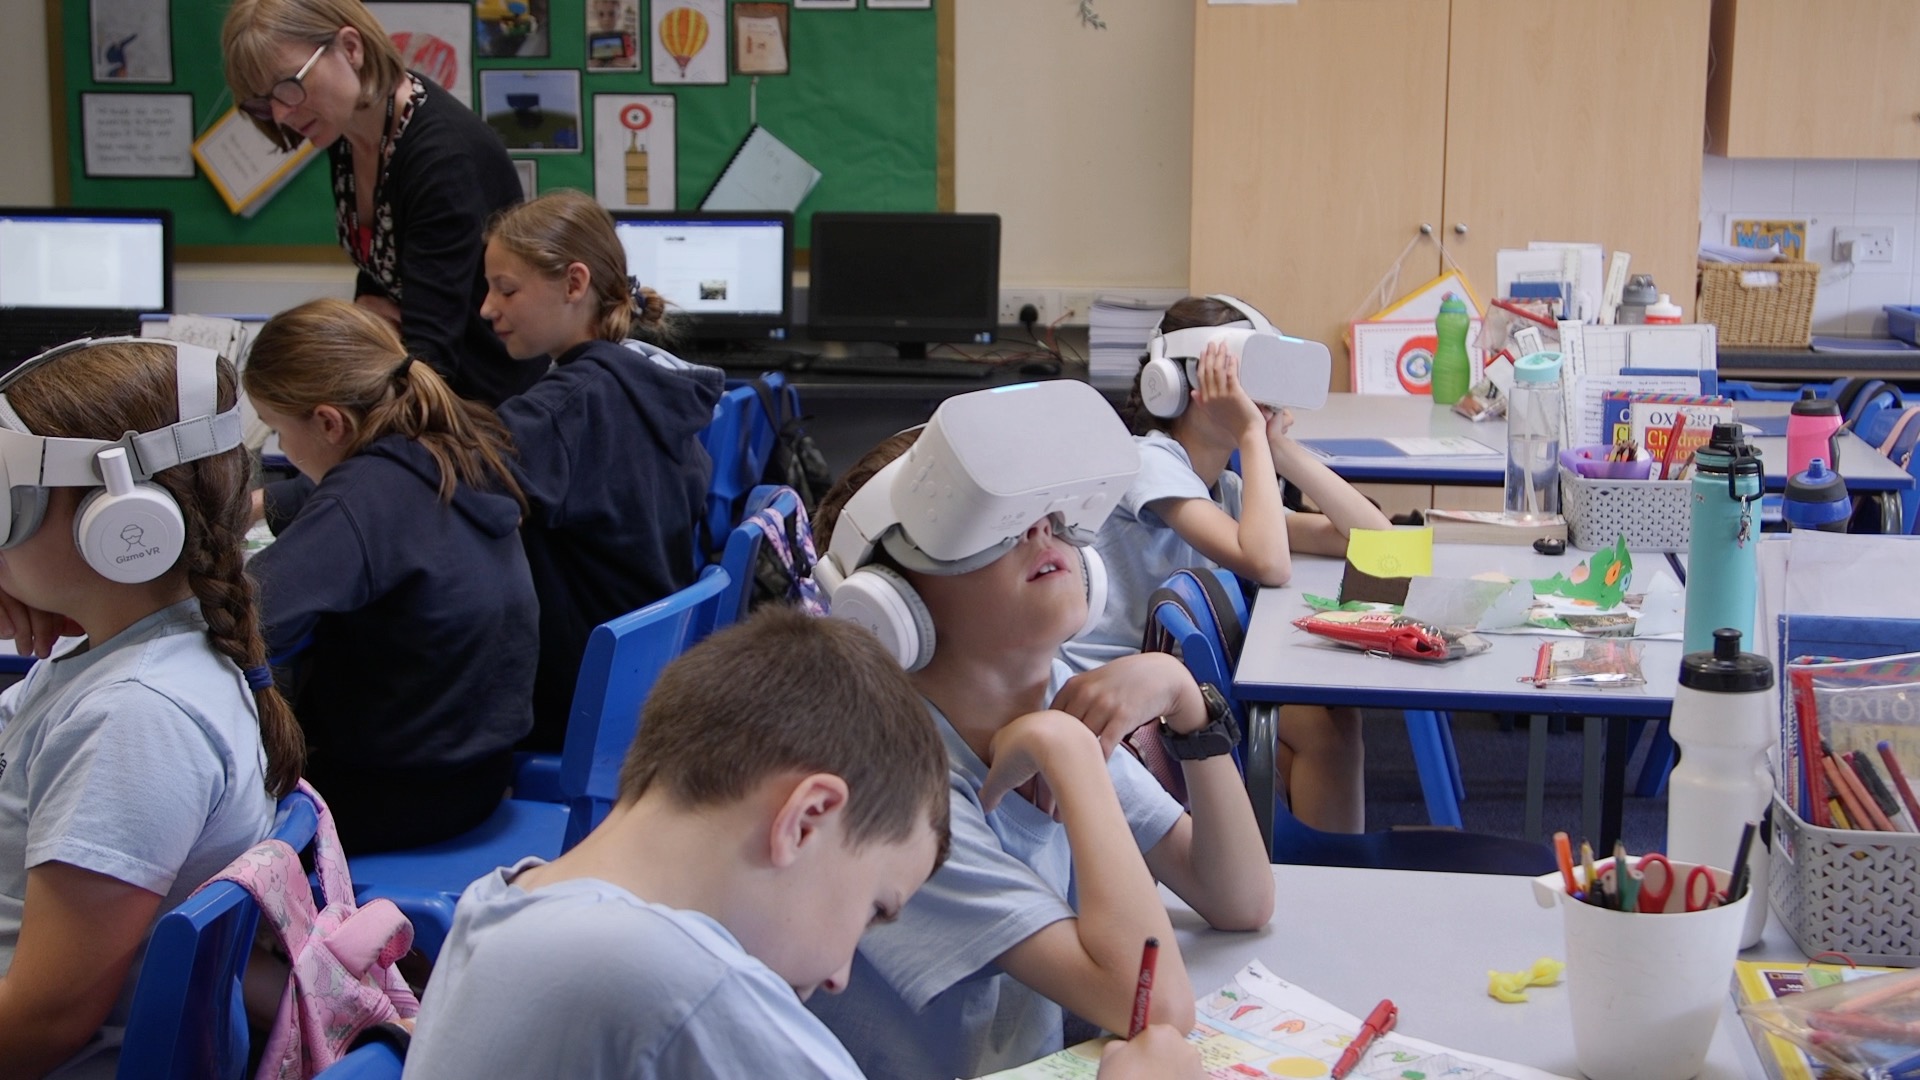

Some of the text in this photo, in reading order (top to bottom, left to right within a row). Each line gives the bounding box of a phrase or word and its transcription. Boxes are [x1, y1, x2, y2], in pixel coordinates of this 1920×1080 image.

[1650, 411, 1721, 427] OXORD
[1647, 430, 1711, 447] Chdren
[115, 546, 161, 564] Gizmo VR
[1829, 693, 1920, 723] OXFO
